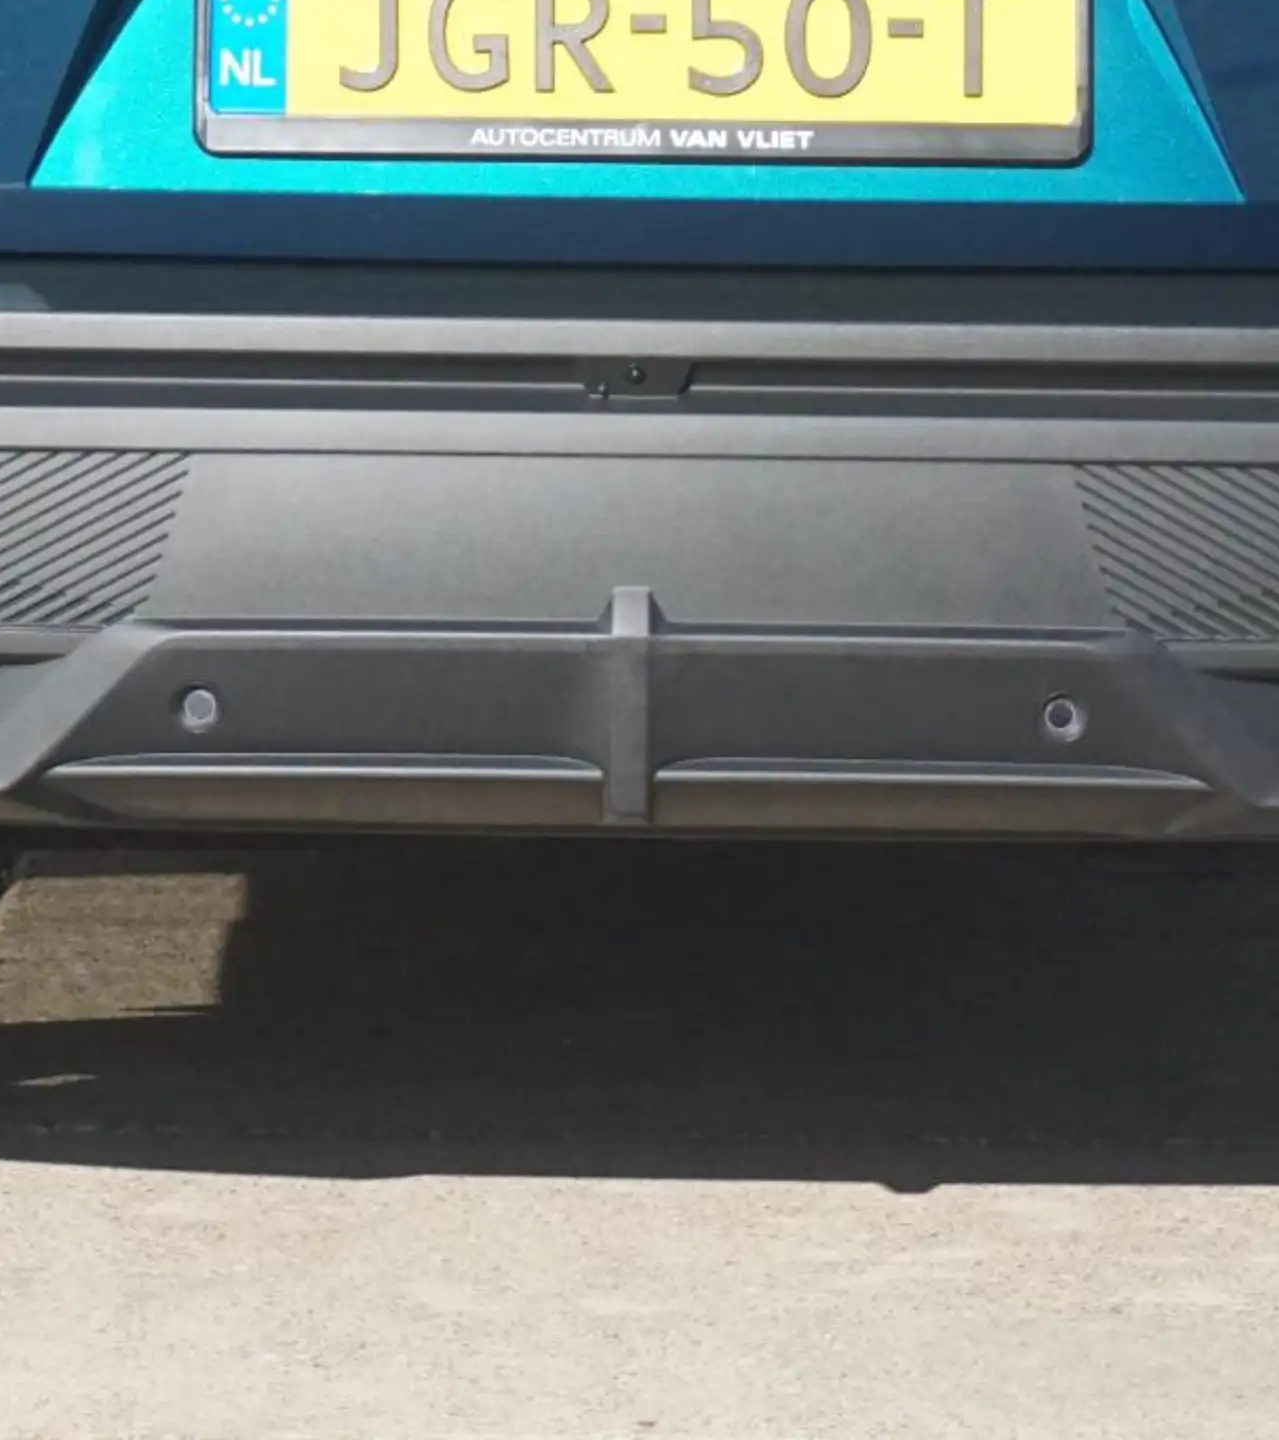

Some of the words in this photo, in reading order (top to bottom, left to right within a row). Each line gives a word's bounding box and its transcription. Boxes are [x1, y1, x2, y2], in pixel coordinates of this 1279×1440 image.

[219, 48, 277, 87] NL
[470, 126, 661, 148] AUTOCENTRUM
[669, 129, 727, 149] VAN
[736, 129, 814, 150] VLIET
